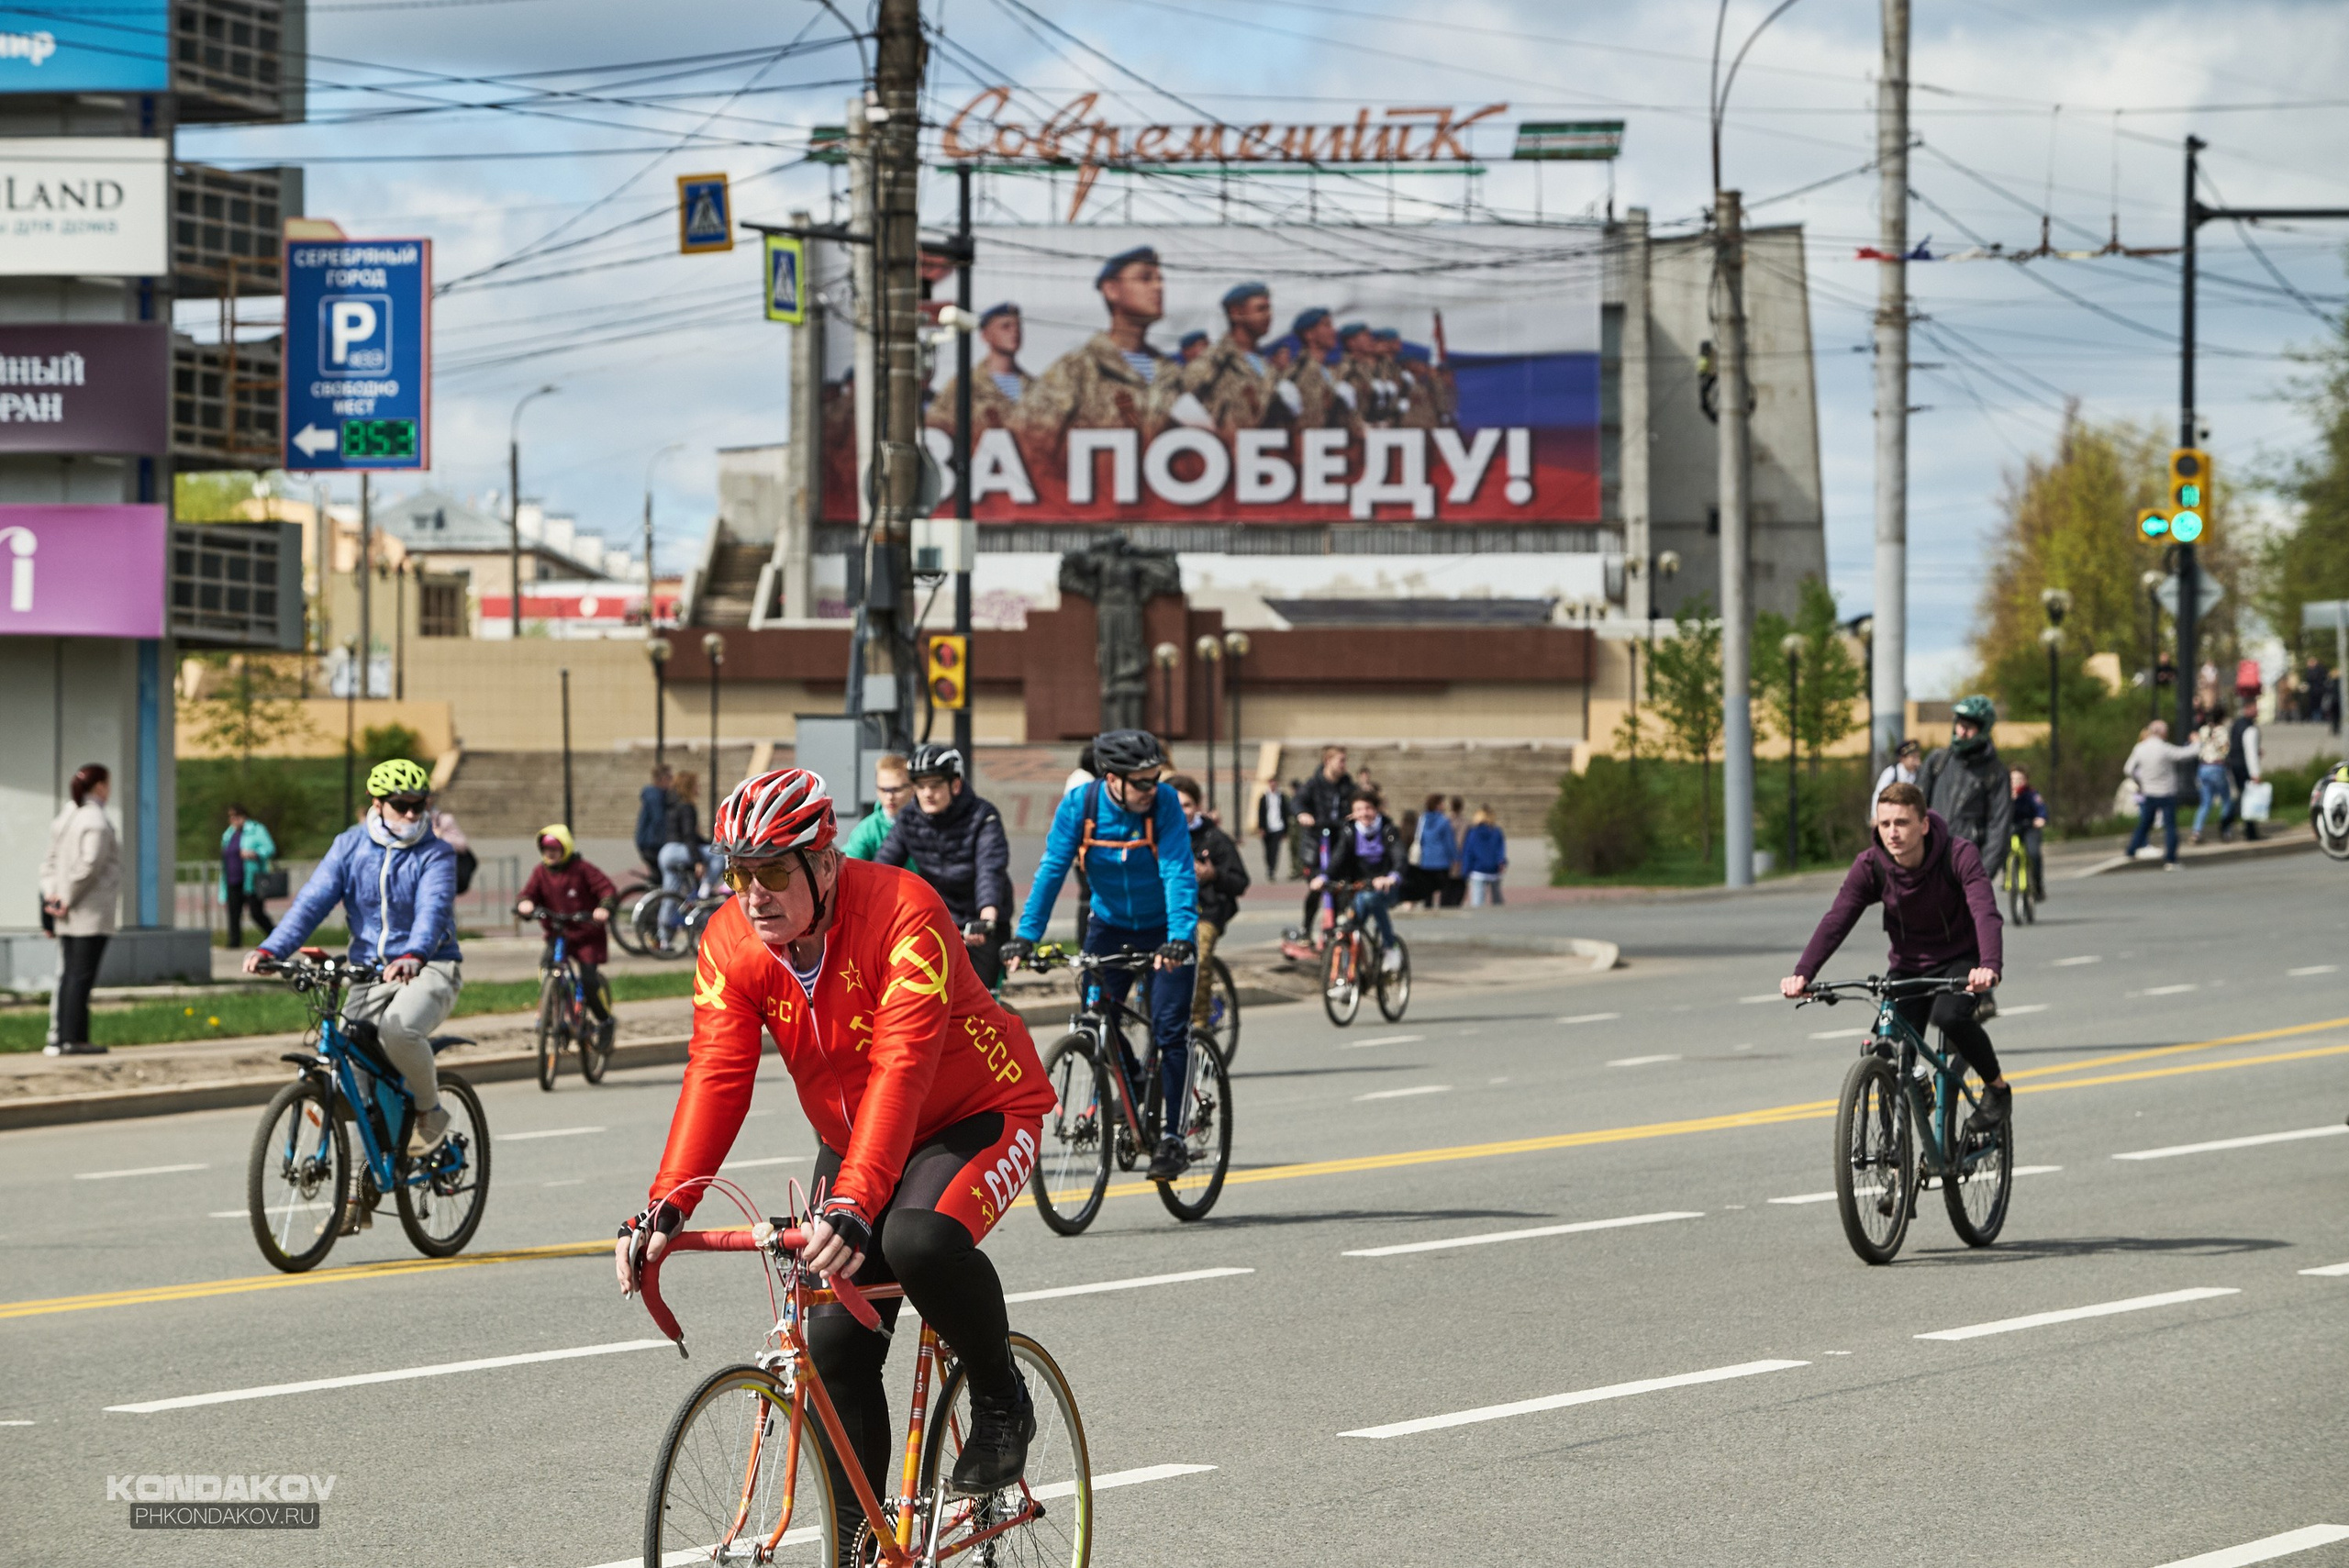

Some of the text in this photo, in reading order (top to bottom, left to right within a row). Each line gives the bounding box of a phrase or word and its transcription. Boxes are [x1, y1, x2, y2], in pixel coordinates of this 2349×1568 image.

[294, 244, 417, 267] СЕРЕБРЯНЫЙ
[325, 268, 387, 289] ГОРОД
[310, 380, 399, 397] СВОБОДНО
[332, 398, 375, 416] МЕСТ
[342, 420, 416, 457] 853
[1066, 427, 1531, 519] ПОБЕДУ!
[767, 995, 798, 1024] СС
[963, 1015, 1022, 1083] СССР
[984, 1128, 1035, 1213] СССР
